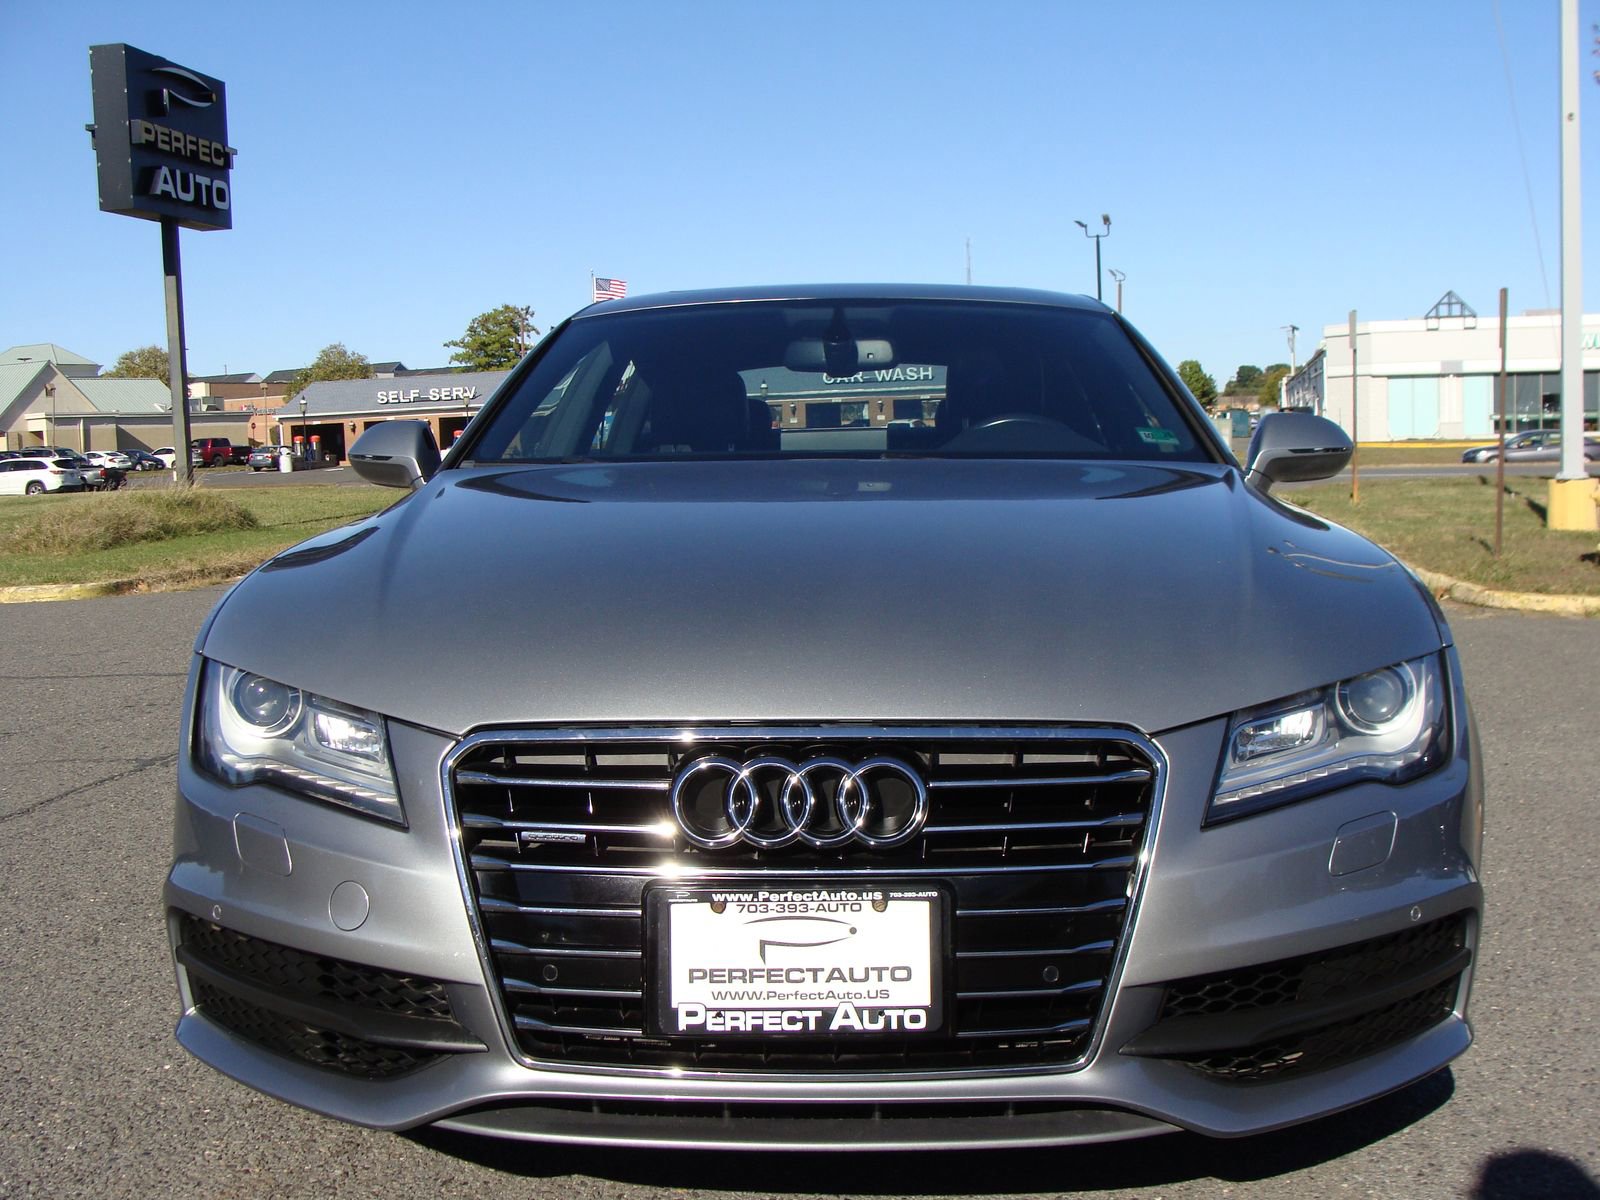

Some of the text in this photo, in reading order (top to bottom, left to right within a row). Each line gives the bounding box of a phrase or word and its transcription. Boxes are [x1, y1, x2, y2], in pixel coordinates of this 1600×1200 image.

[138, 119, 238, 169] PERFECT
[153, 166, 230, 210] AUTO
[874, 366, 933, 382] WASH
[377, 386, 476, 405] SELF SERV
[711, 890, 883, 903] www.PerfectAuto.us
[736, 902, 862, 914] 703-393-AUTO
[688, 966, 912, 984] PERFECTAUTO
[711, 989, 890, 1001] WWW.PerfectAuto.US
